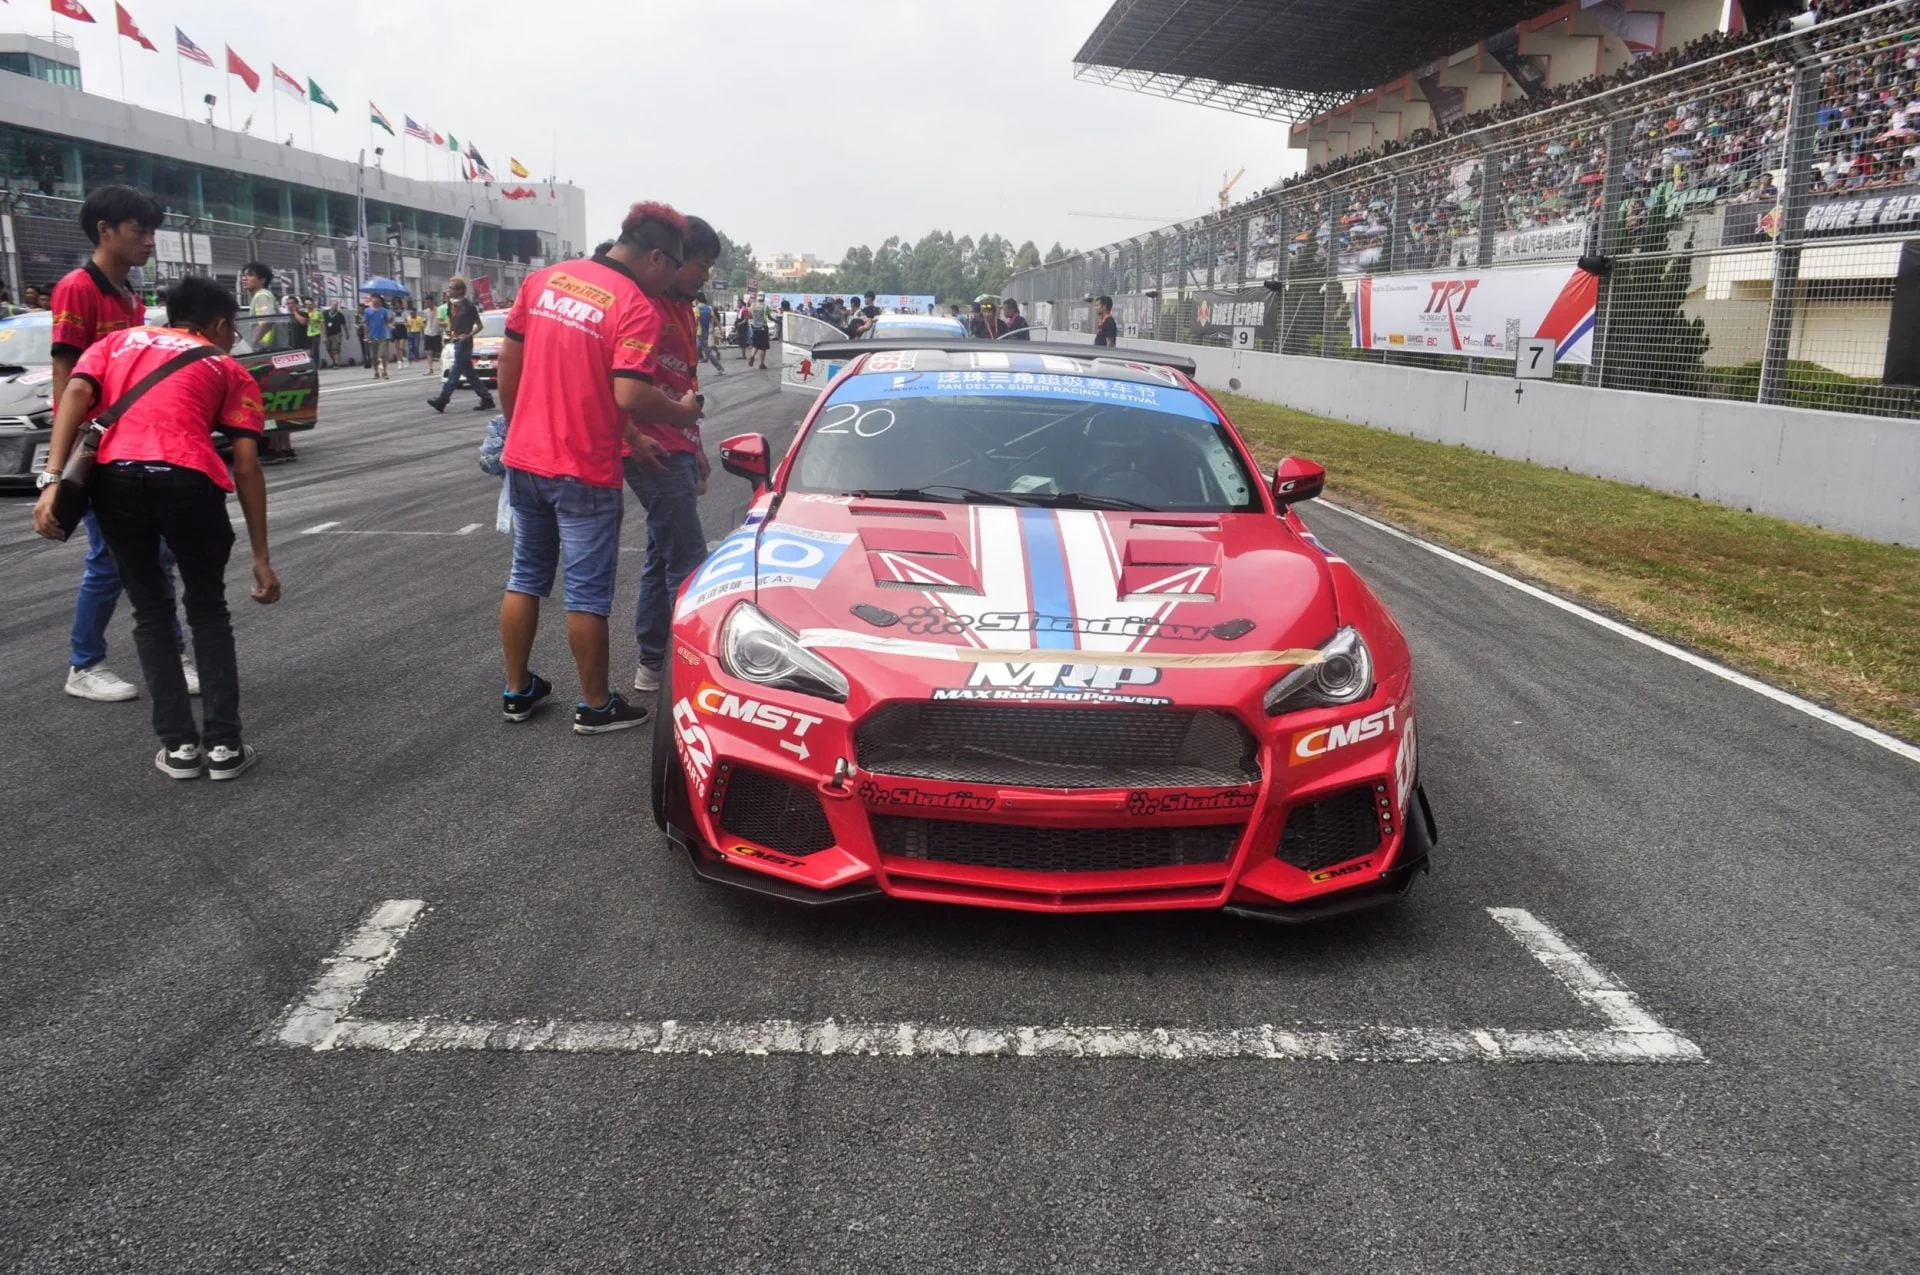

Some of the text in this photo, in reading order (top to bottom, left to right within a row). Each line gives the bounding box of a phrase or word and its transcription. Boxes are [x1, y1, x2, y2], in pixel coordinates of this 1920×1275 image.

[536, 288, 604, 324] MRP
[1423, 279, 1481, 316] TRT
[1126, 325, 1137, 336] 11
[1239, 331, 1249, 345] 9
[1528, 346, 1544, 369] 7
[937, 371, 1157, 398] 泛珠三角超级赛车节
[937, 382, 1161, 406] PAN DELTA SUPER RACING FESTIVAL
[816, 403, 895, 437] 20
[696, 537, 825, 588] 20
[966, 662, 1162, 691] MRP
[933, 689, 991, 701] MAX
[697, 688, 824, 738] CMST
[1295, 704, 1396, 758] CMST
[683, 751, 705, 798] PARTS
[735, 846, 807, 868] CMST
[1313, 859, 1373, 881] CMST
